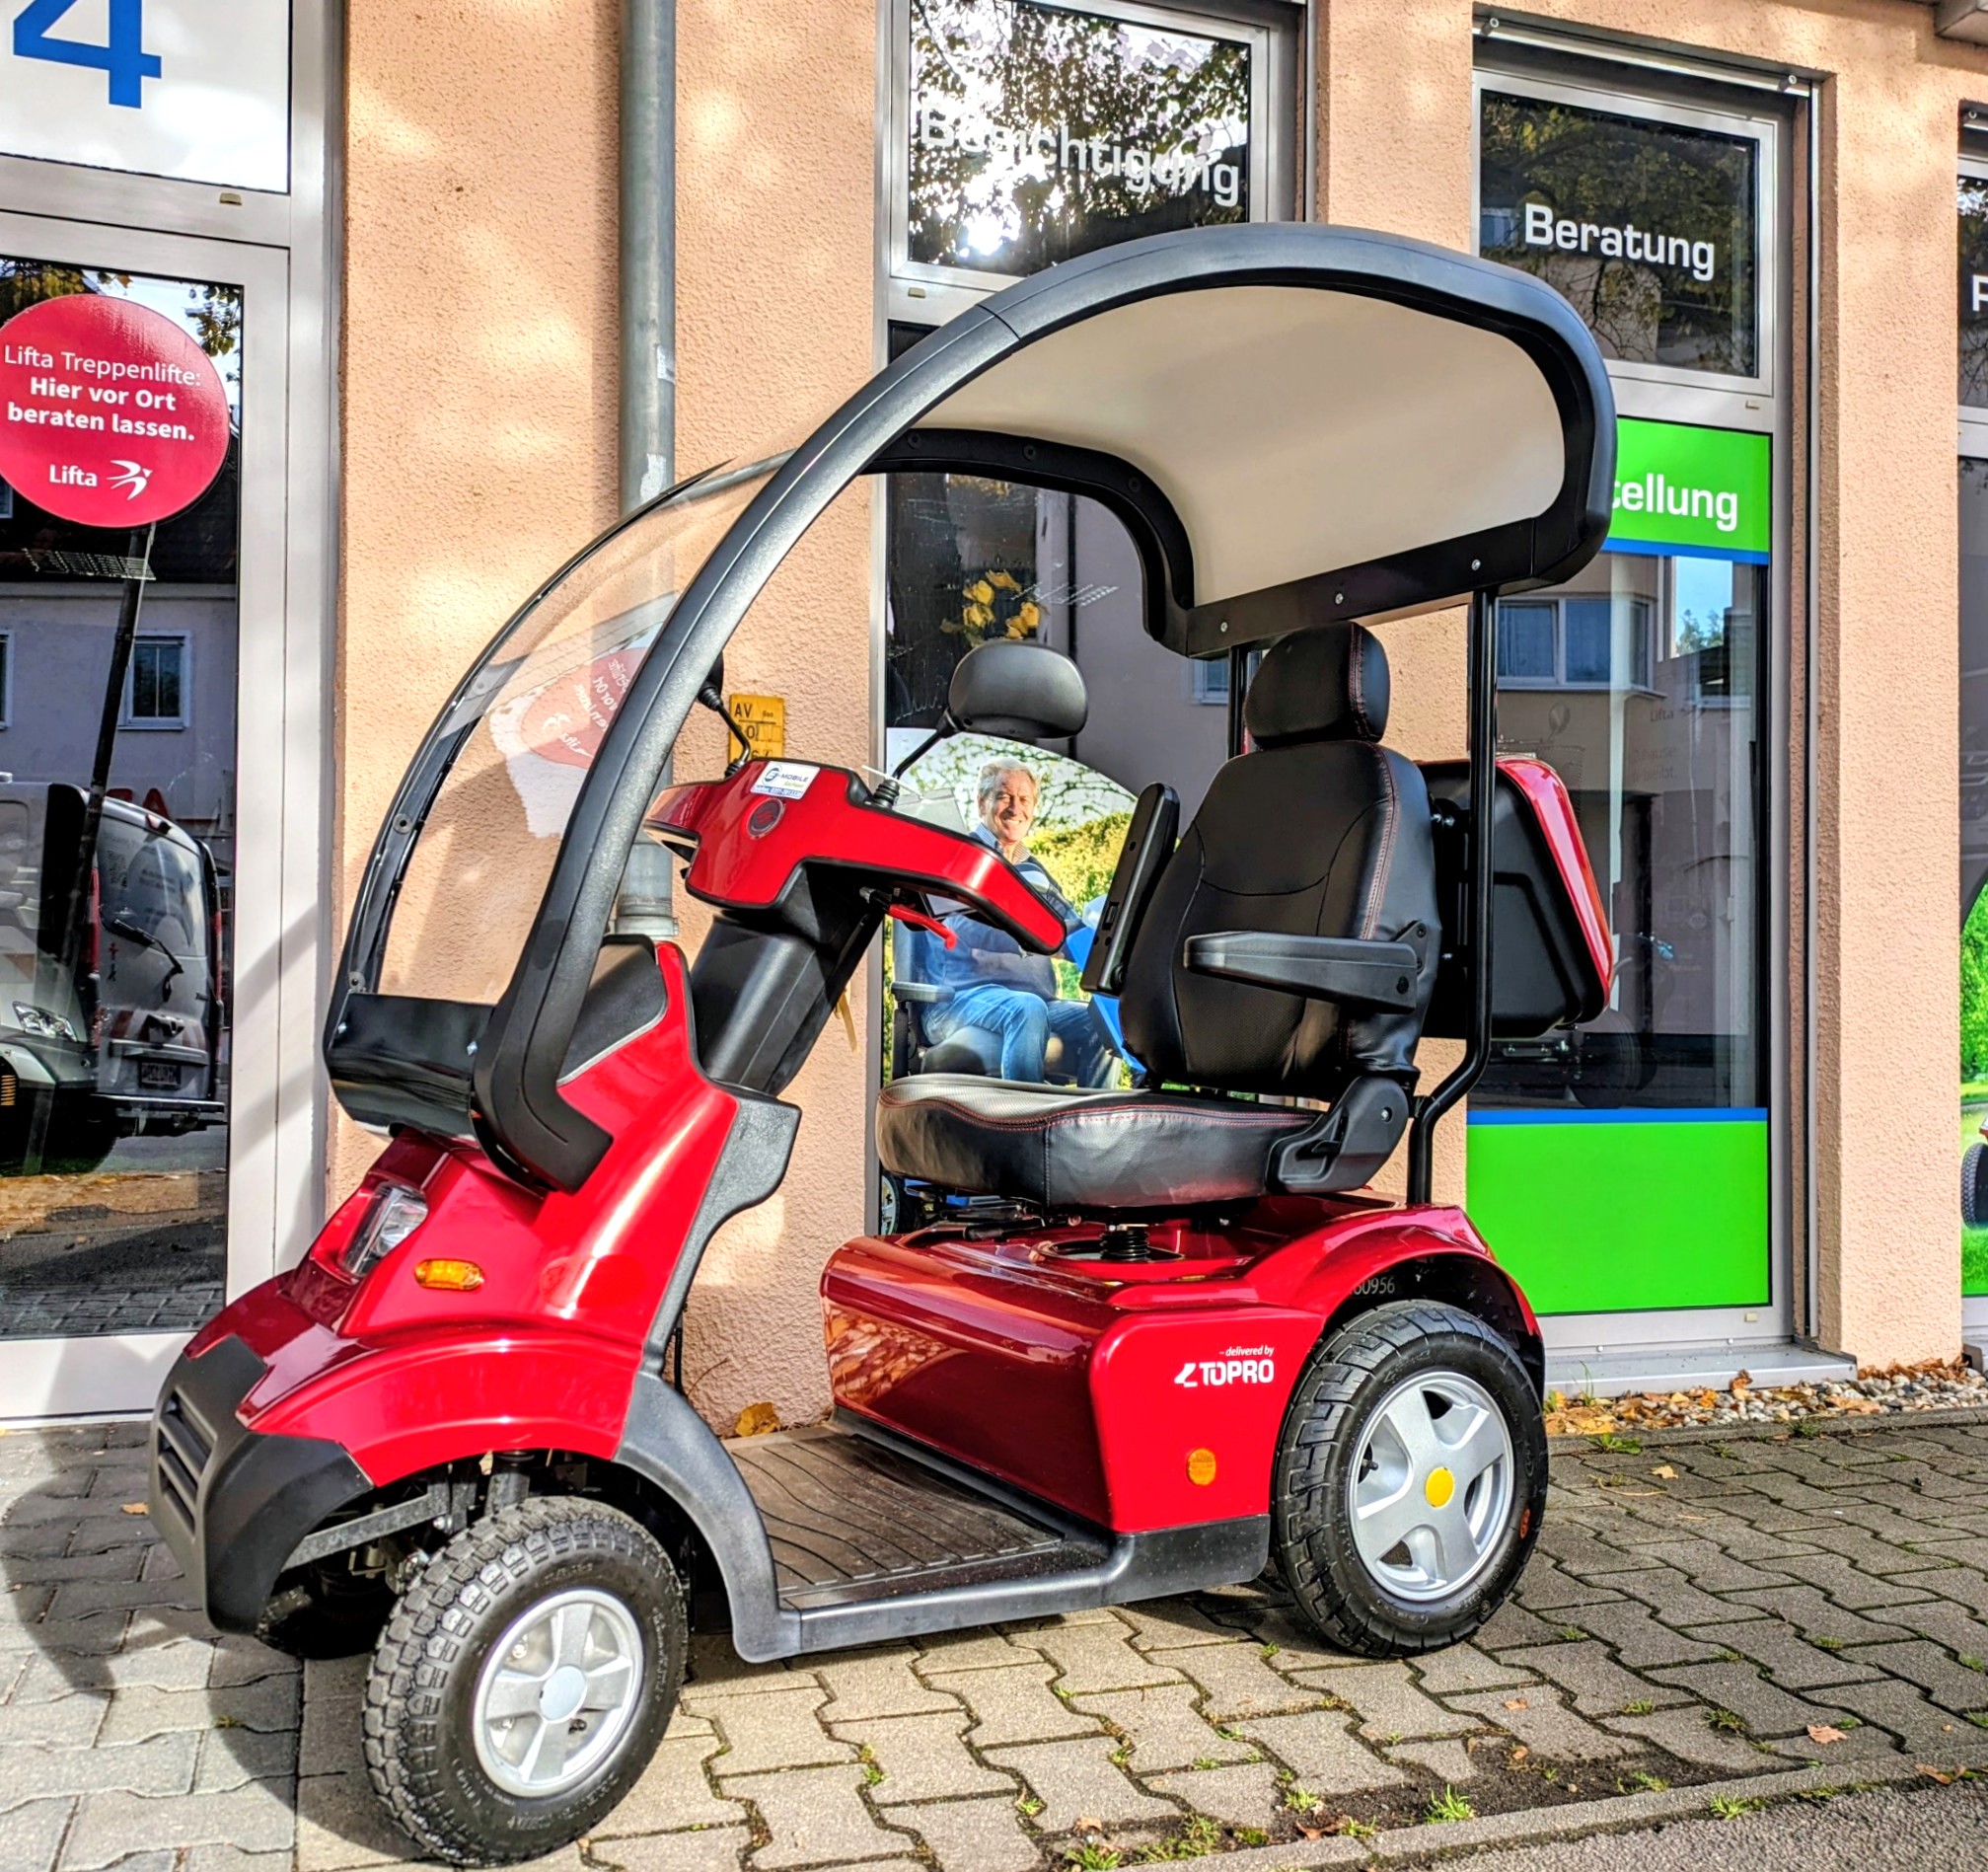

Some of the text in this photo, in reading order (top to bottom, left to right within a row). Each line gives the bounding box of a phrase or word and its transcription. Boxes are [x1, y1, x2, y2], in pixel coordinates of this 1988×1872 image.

[13, 0, 163, 110] 4
[920, 99, 1239, 207] Besichtigung
[1525, 202, 1715, 282] Beratung
[4, 344, 201, 387] Lifta Treppenlifte:
[30, 376, 177, 412] Hier vor Ort
[8, 401, 195, 441] beraten lassen.
[49, 464, 98, 487] Lifta
[734, 703, 753, 718] AV
[1225, 1345, 1263, 1357] delivered
[1264, 1345, 1275, 1357] by
[1199, 1359, 1275, 1386] TOPRO
